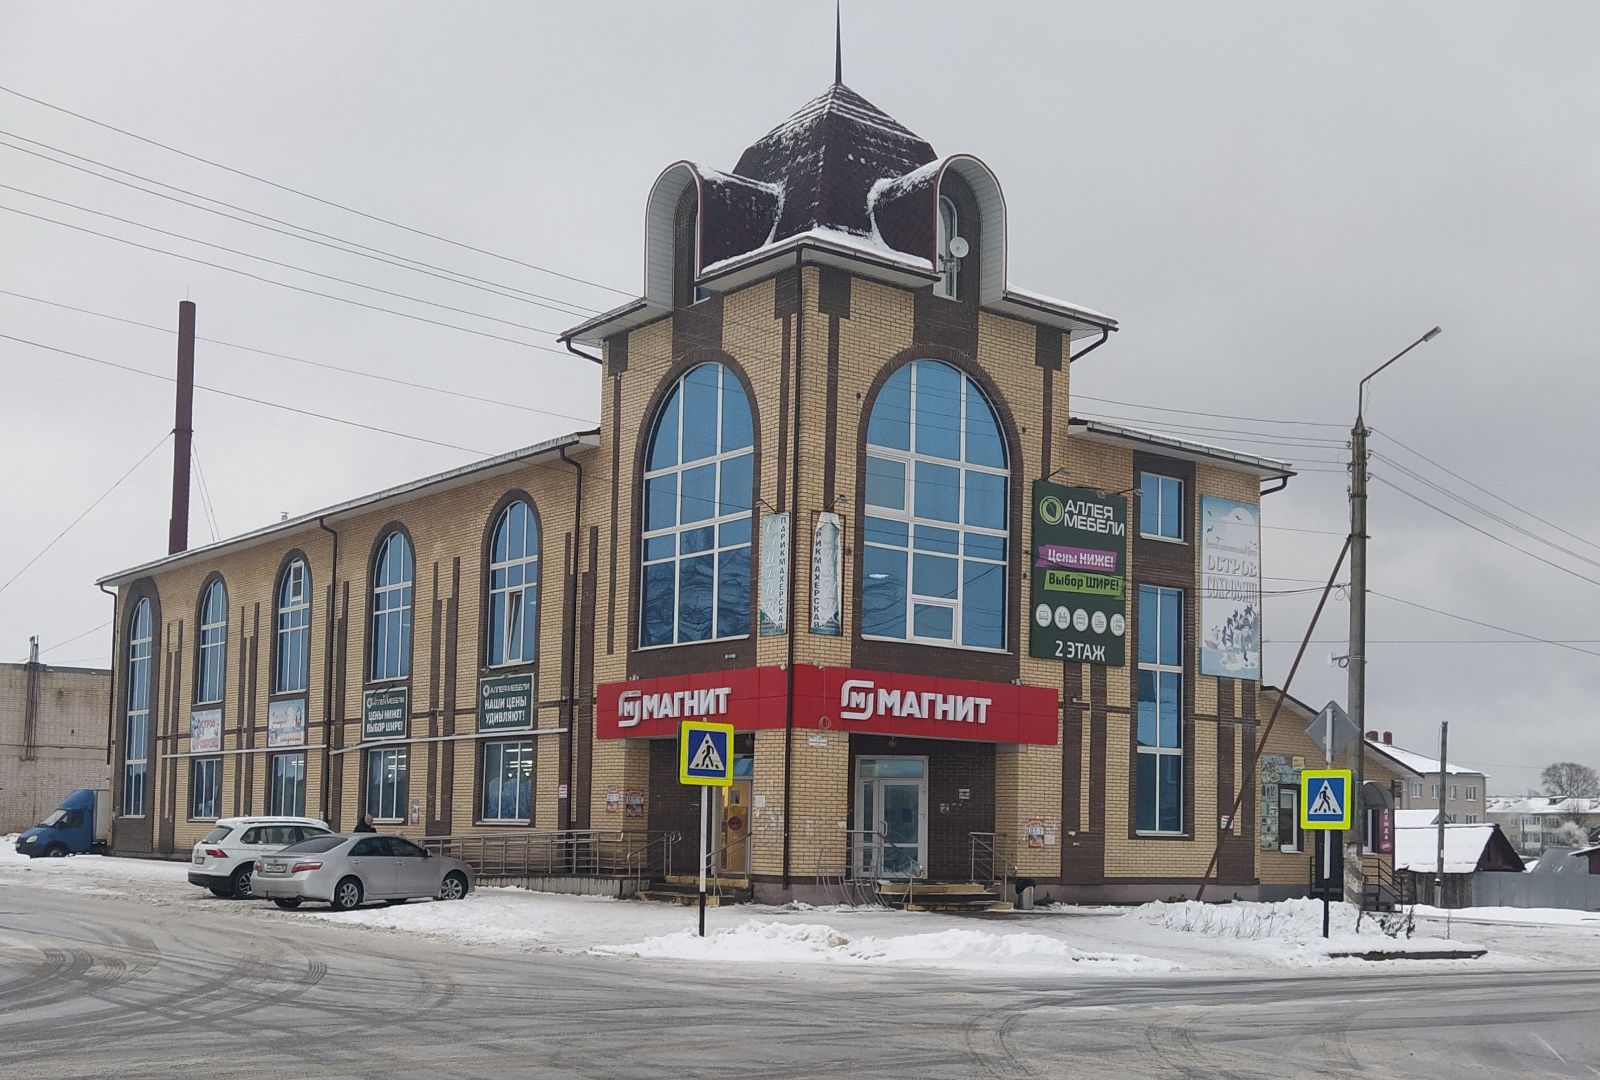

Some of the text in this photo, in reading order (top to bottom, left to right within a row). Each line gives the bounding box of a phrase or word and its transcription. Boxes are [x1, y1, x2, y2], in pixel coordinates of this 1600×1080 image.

[1064, 499, 1113, 520] АЛЛЕЯ
[1064, 513, 1125, 537] МЕБЕЛИ
[1048, 548, 1114, 568] Цены НИЖЕ!
[1208, 554, 1258, 578] ОСТРОВ
[1048, 572, 1119, 591] Выбор ШИРЕ!
[1055, 640, 1105, 662] 2 ЭТАЖ
[484, 695, 527, 710] НАШИ ЦЕНЫ
[642, 687, 732, 720] МАГНИТ
[877, 688, 992, 724] МАГНИТ
[485, 709, 526, 725] УДИВЛЯЮТ!
